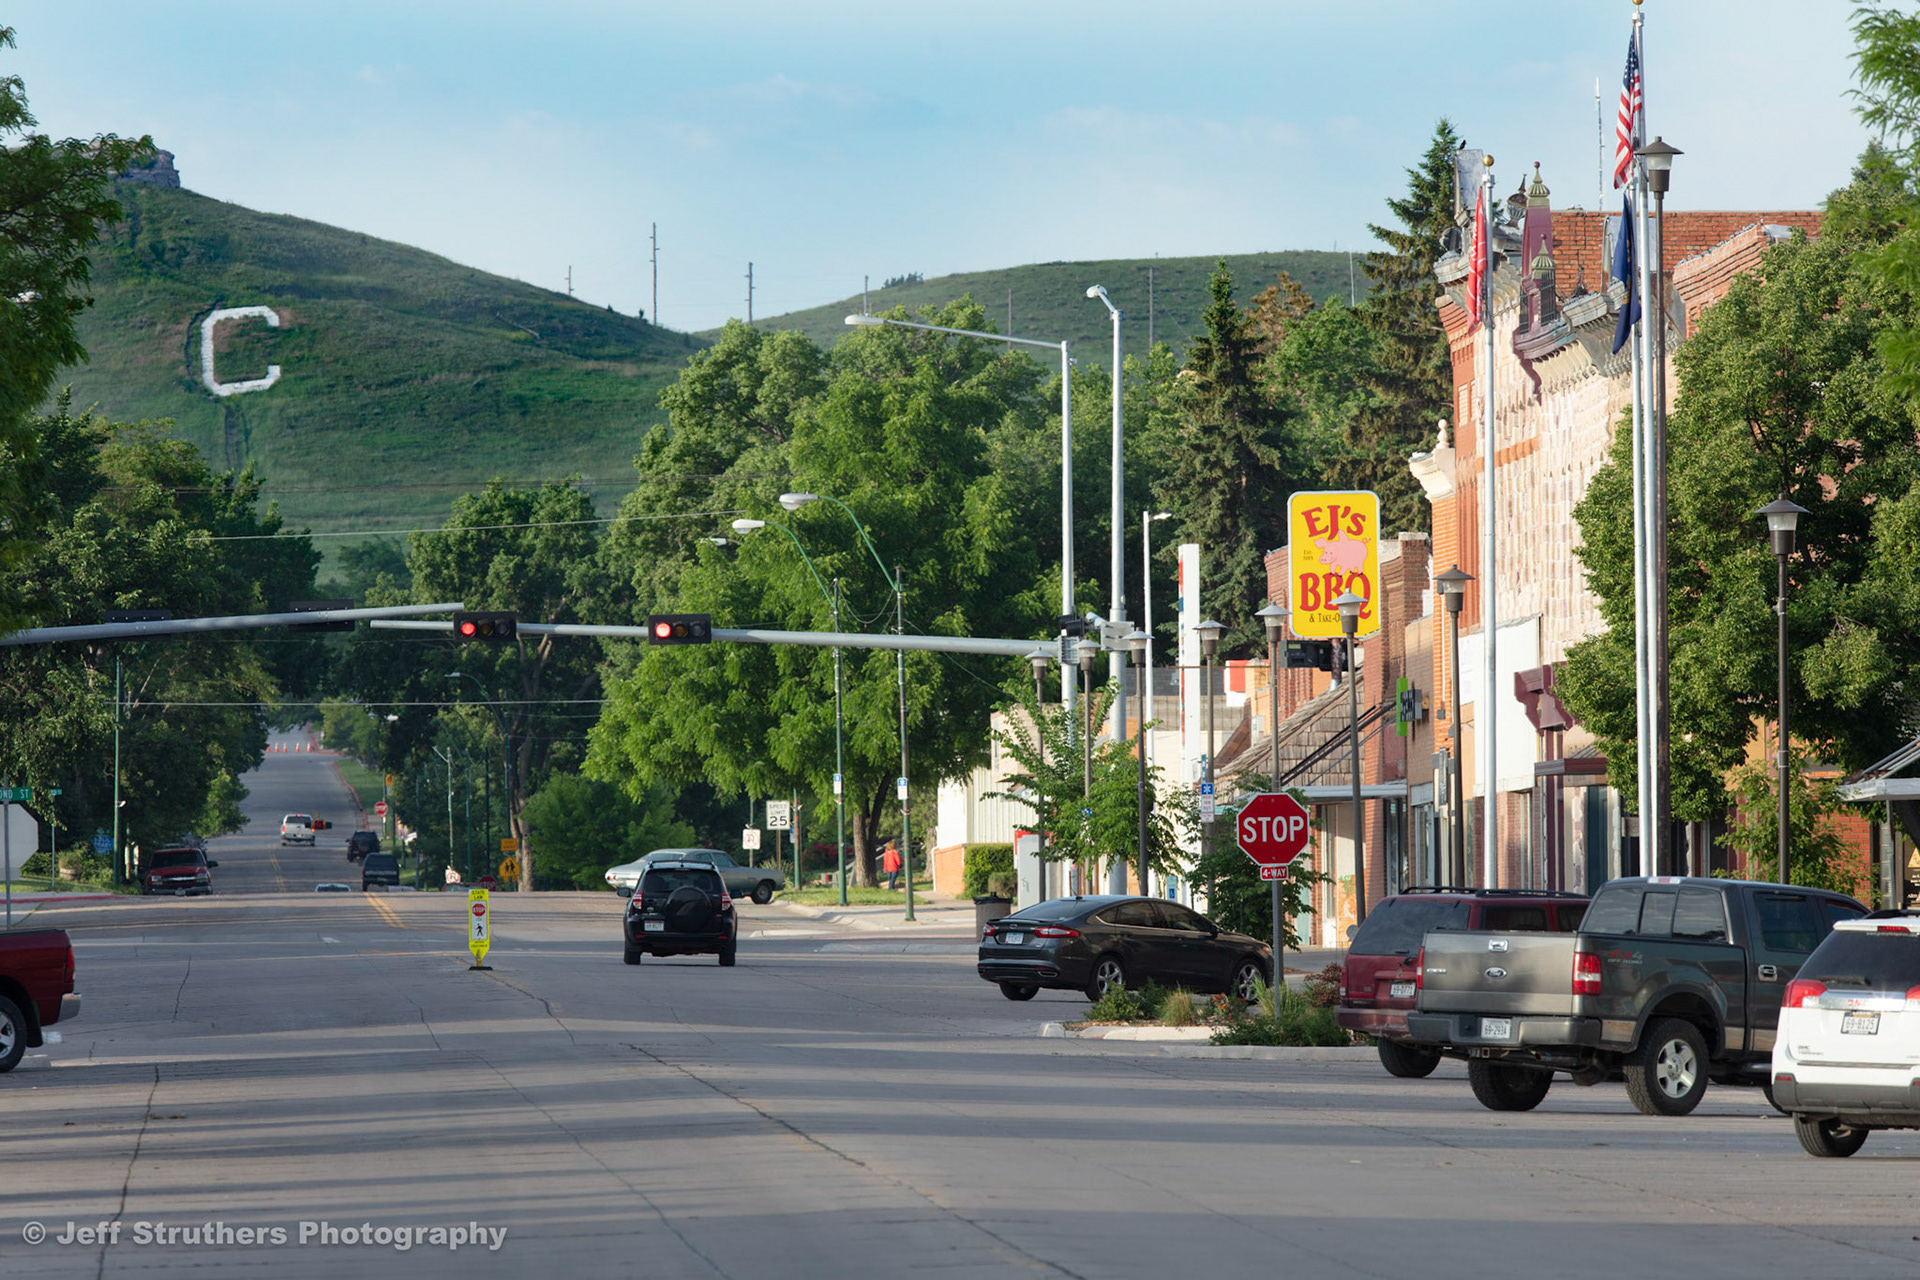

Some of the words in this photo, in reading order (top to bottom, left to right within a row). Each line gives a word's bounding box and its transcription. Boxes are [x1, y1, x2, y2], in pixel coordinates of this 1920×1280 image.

[201, 306, 280, 396] C
[1301, 505, 1366, 541] EJ's
[1299, 573, 1372, 619] BBQ
[1309, 613, 1316, 623] &
[20, 788, 29, 799] ST
[770, 816, 788, 827] 25
[1242, 816, 1304, 843] STOP
[1262, 868, 1287, 879] 4-WAY
